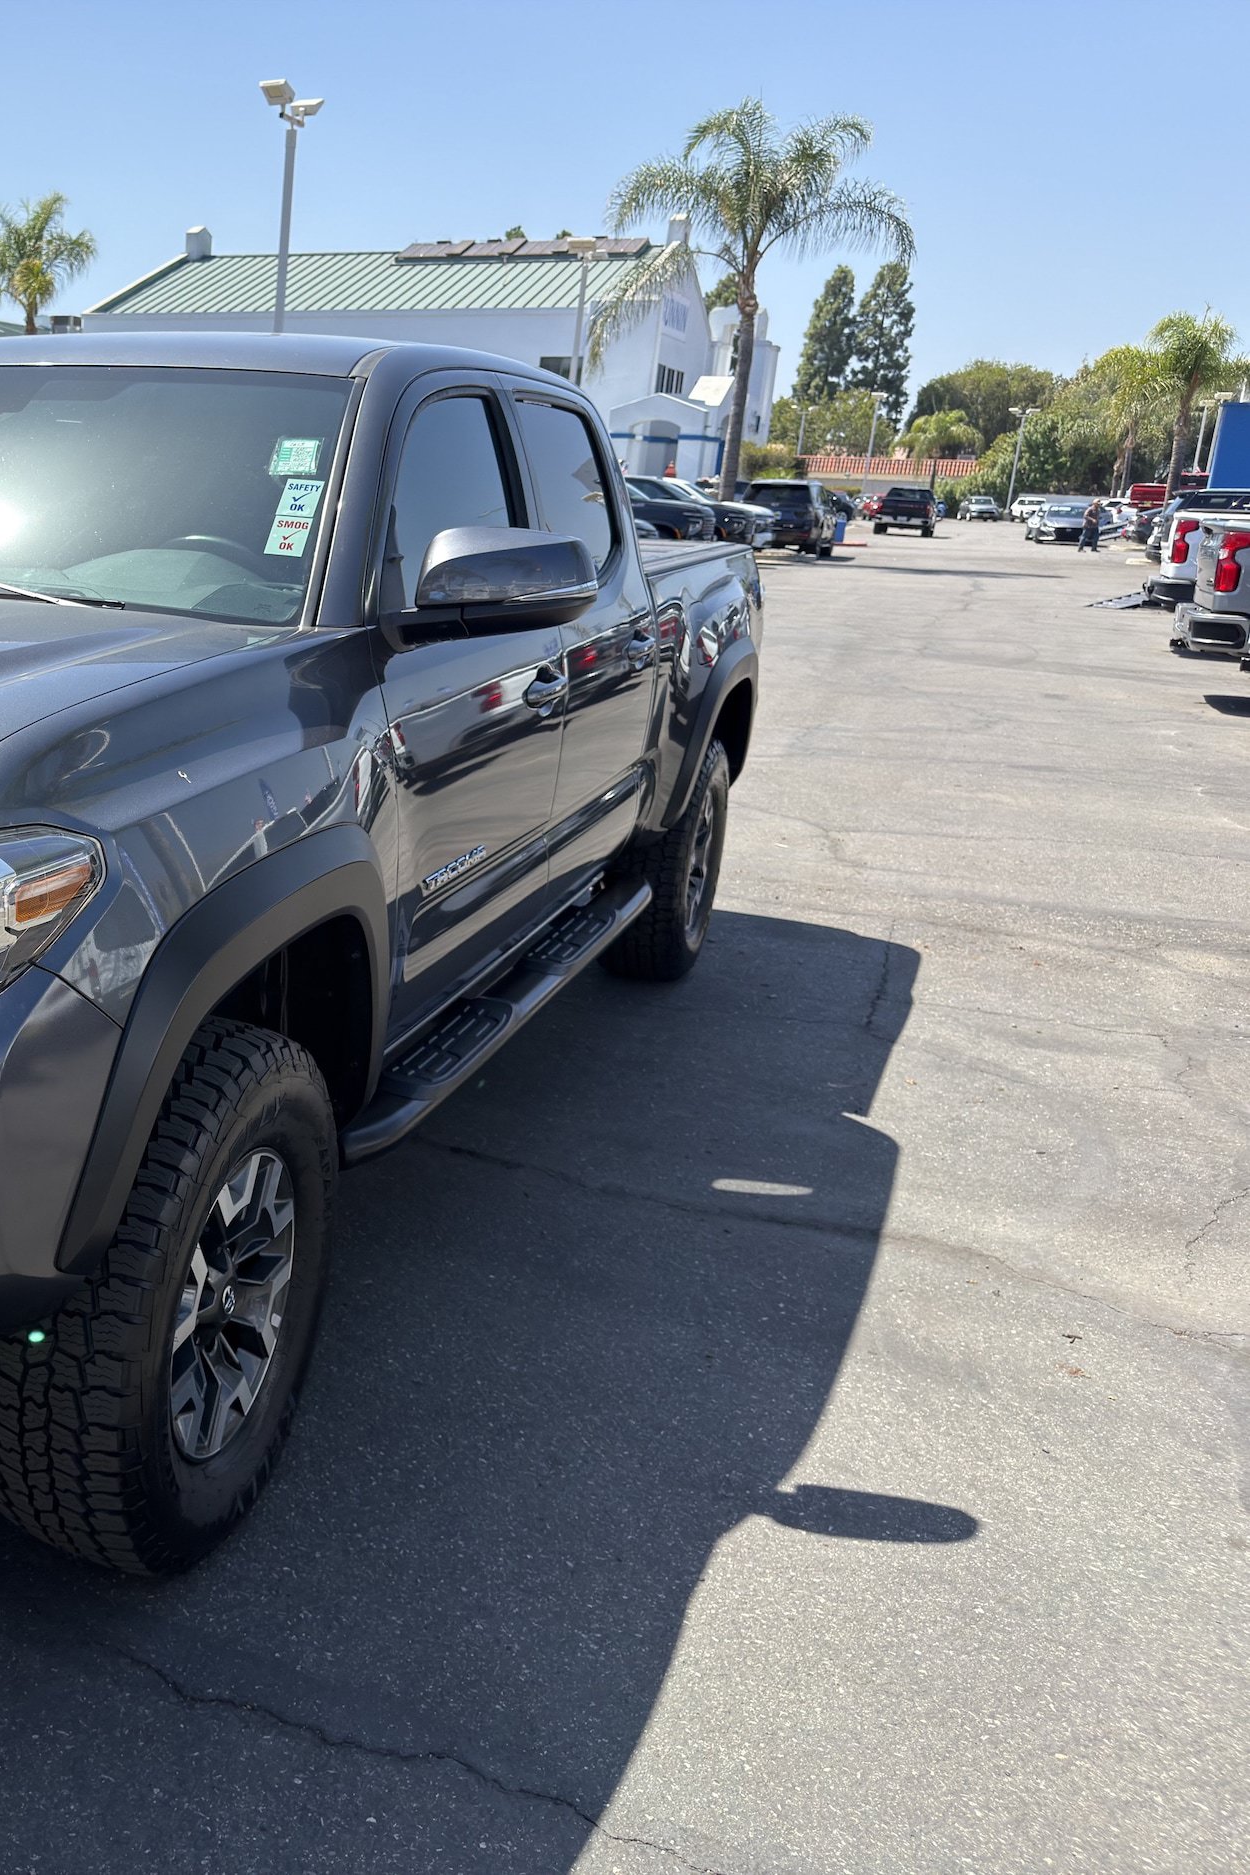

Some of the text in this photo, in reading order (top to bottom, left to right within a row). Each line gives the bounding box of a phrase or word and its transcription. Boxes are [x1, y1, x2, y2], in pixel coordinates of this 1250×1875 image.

[287, 483, 321, 492] SAFETY
[290, 503, 305, 511] OK
[277, 520, 309, 530] SMOG
[279, 542, 294, 551] OK
[422, 845, 487, 890] TACOMA
